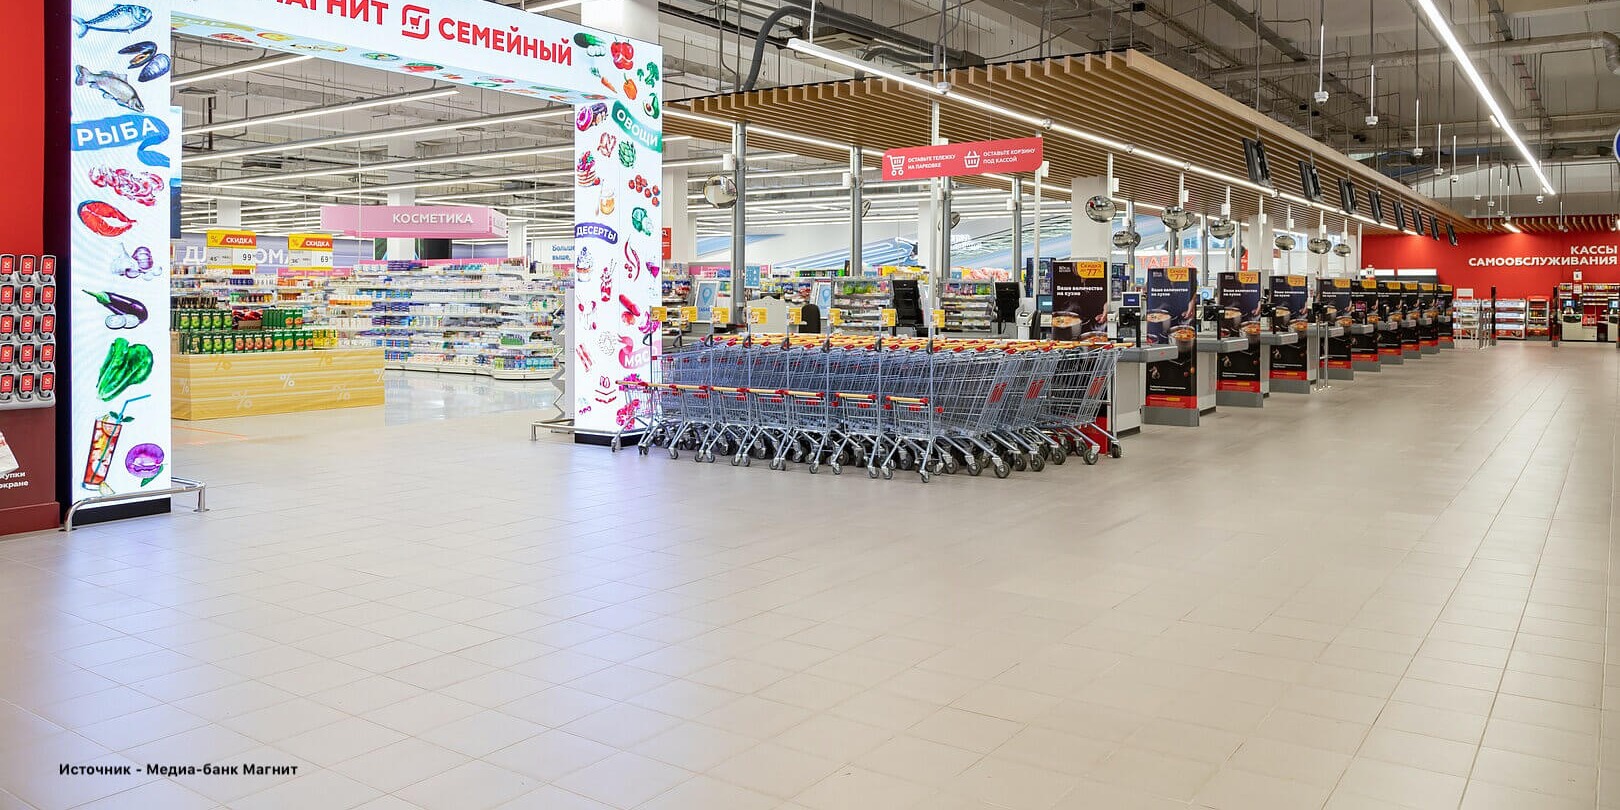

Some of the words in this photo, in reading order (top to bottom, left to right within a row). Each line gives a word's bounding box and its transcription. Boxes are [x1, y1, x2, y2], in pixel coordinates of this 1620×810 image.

[276, 0, 389, 26] НИТ
[438, 17, 573, 67] СЕМЕЙНЫЙ
[76, 117, 160, 148] РЫБА
[616, 108, 659, 147] ОВОЩИ
[907, 155, 933, 163] ОСТАВЬТЕ
[933, 153, 956, 161] ТЕЛЕЖКУ
[983, 149, 1010, 157] ОСТАВЬТЕ
[1010, 148, 1036, 156] КОРЗИНУ
[996, 155, 1018, 164] КАССОЙ
[916, 162, 942, 170] ПАРКОВКЕ
[392, 213, 475, 224] КОСМЕТИКА
[576, 225, 617, 241] ДЕСЕРТЫ
[1570, 245, 1618, 255] КАССЫ
[1468, 256, 1618, 267] САМООБСЛУЖИВАНИЯ
